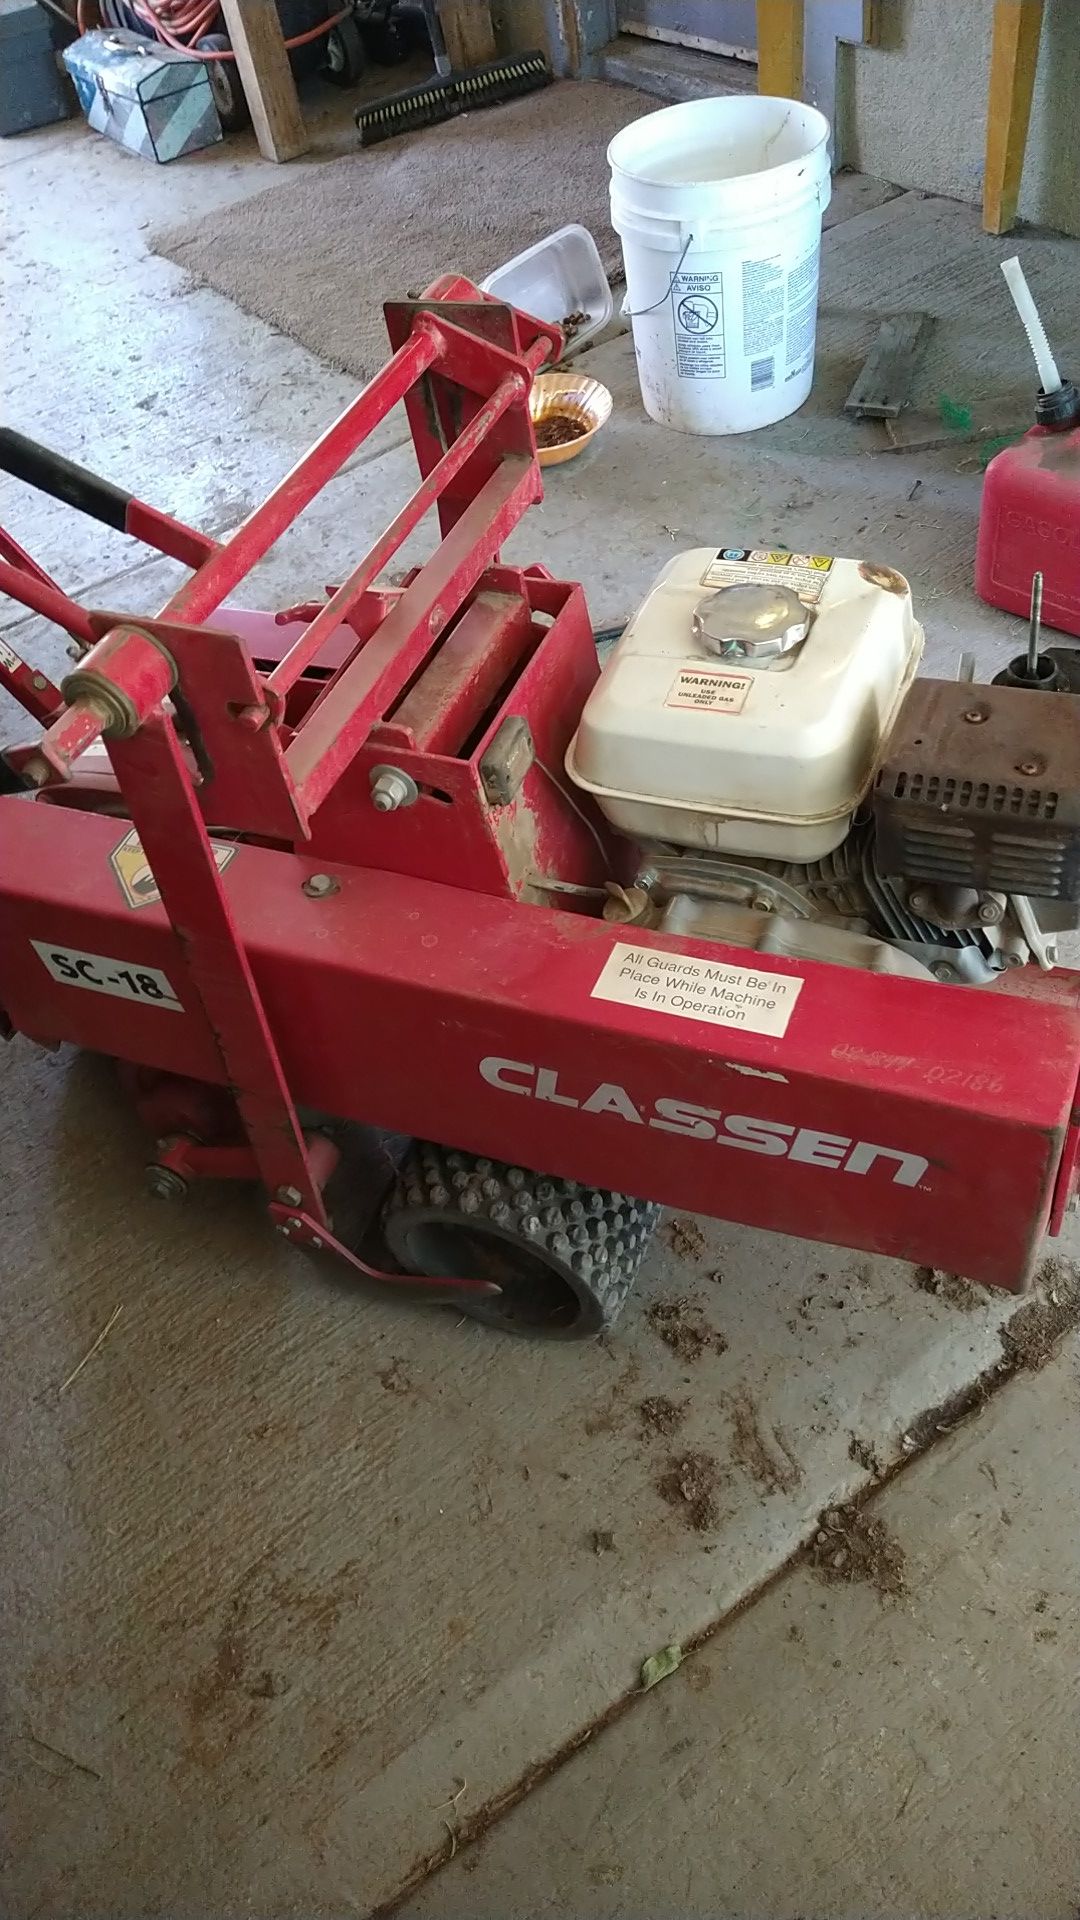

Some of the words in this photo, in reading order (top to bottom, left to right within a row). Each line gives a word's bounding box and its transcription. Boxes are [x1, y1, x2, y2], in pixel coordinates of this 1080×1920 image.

[678, 692, 717, 700] UNLEADED
[680, 676, 746, 690] WARNING!
[51, 953, 164, 999] SC-18
[619, 967, 660, 985] Place
[665, 977, 706, 995] While
[710, 987, 777, 1009] Machine
[623, 952, 642, 965] All
[647, 957, 700, 977] Guards
[704, 968, 742, 985] Must
[746, 977, 768, 991] Be
[772, 982, 787, 994] In
[634, 987, 647, 999] Is
[652, 991, 666, 1003] In
[670, 995, 746, 1020] Operation
[478, 1056, 929, 1187] CLASSEN
